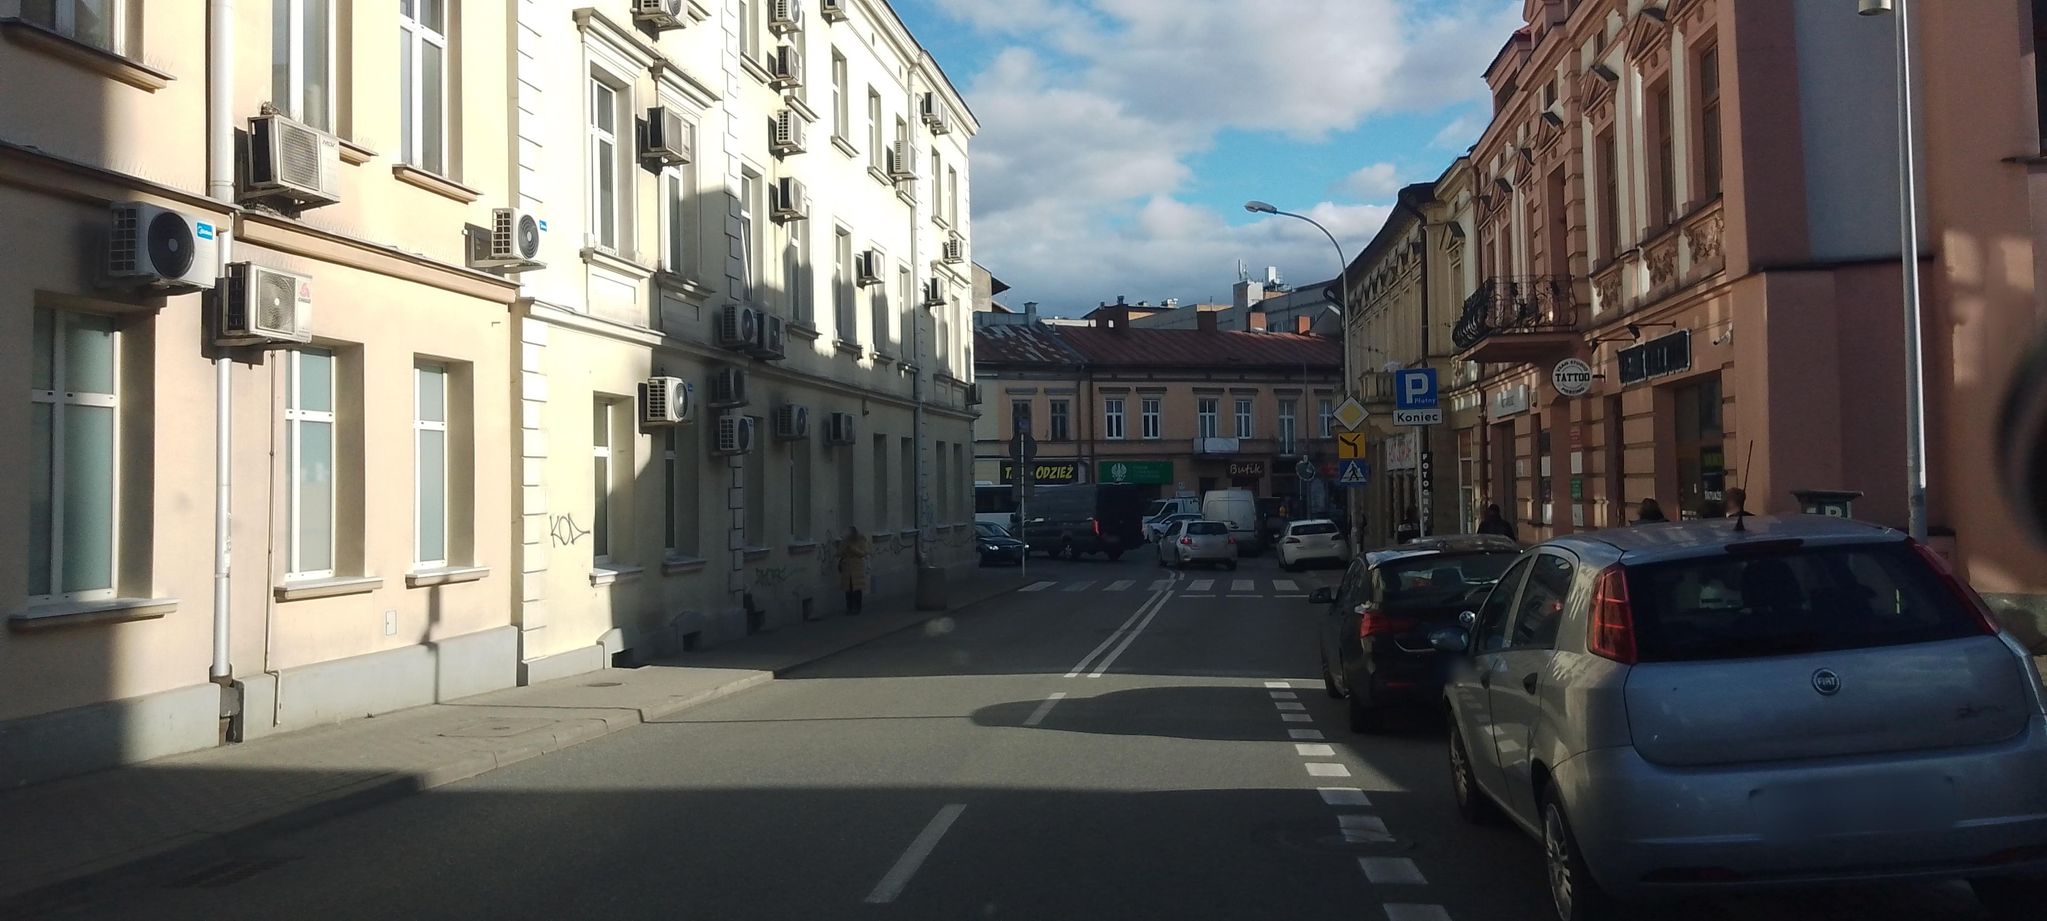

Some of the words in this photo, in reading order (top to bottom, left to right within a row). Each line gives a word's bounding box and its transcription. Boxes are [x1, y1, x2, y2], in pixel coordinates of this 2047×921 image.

[1555, 373, 1590, 382] TATTOO
[1405, 373, 1428, 404] P
[1397, 412, 1439, 422] Koniec
[1035, 464, 1074, 480] ODZIEŻ
[1230, 463, 1262, 475] Butik
[1817, 676, 1835, 686] FIAT
